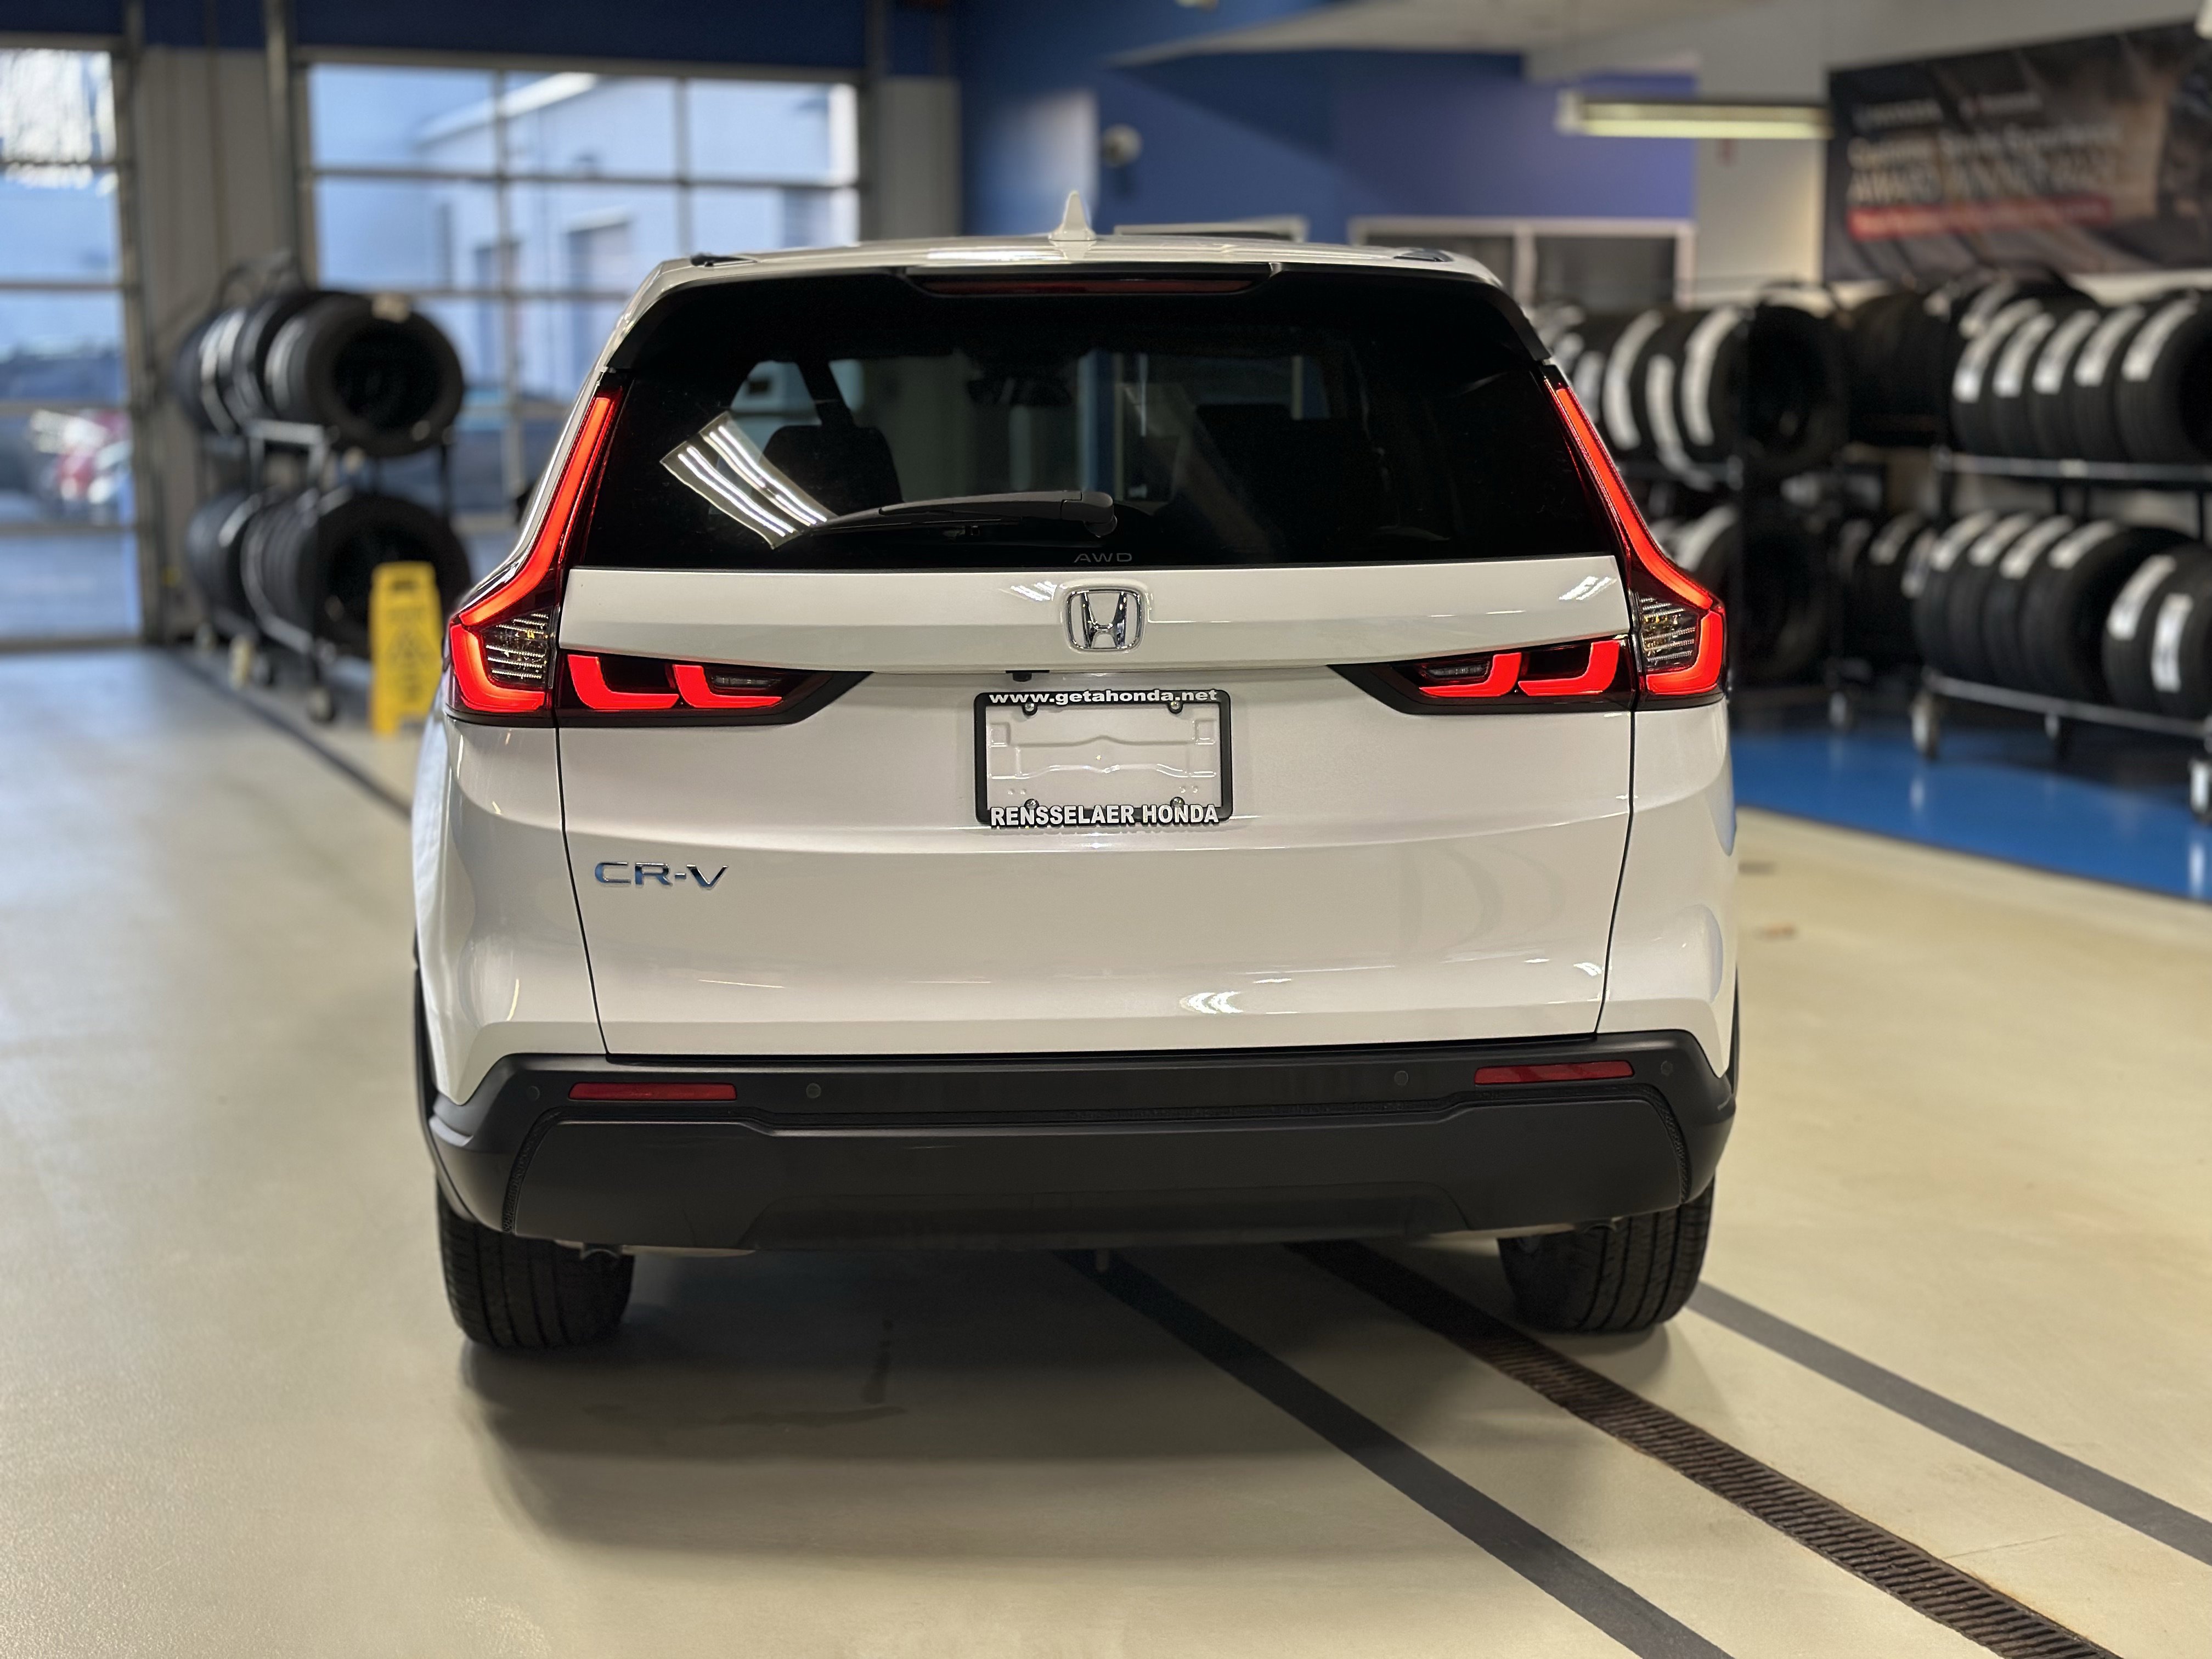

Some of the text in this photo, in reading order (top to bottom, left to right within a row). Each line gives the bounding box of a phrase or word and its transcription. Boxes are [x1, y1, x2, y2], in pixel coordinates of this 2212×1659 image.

[1074, 552, 1132, 563] AWD
[989, 689, 1217, 706] www.getahonda.net
[991, 804, 1219, 826] RENSSELAER HONDA
[595, 862, 729, 888] CR-V
